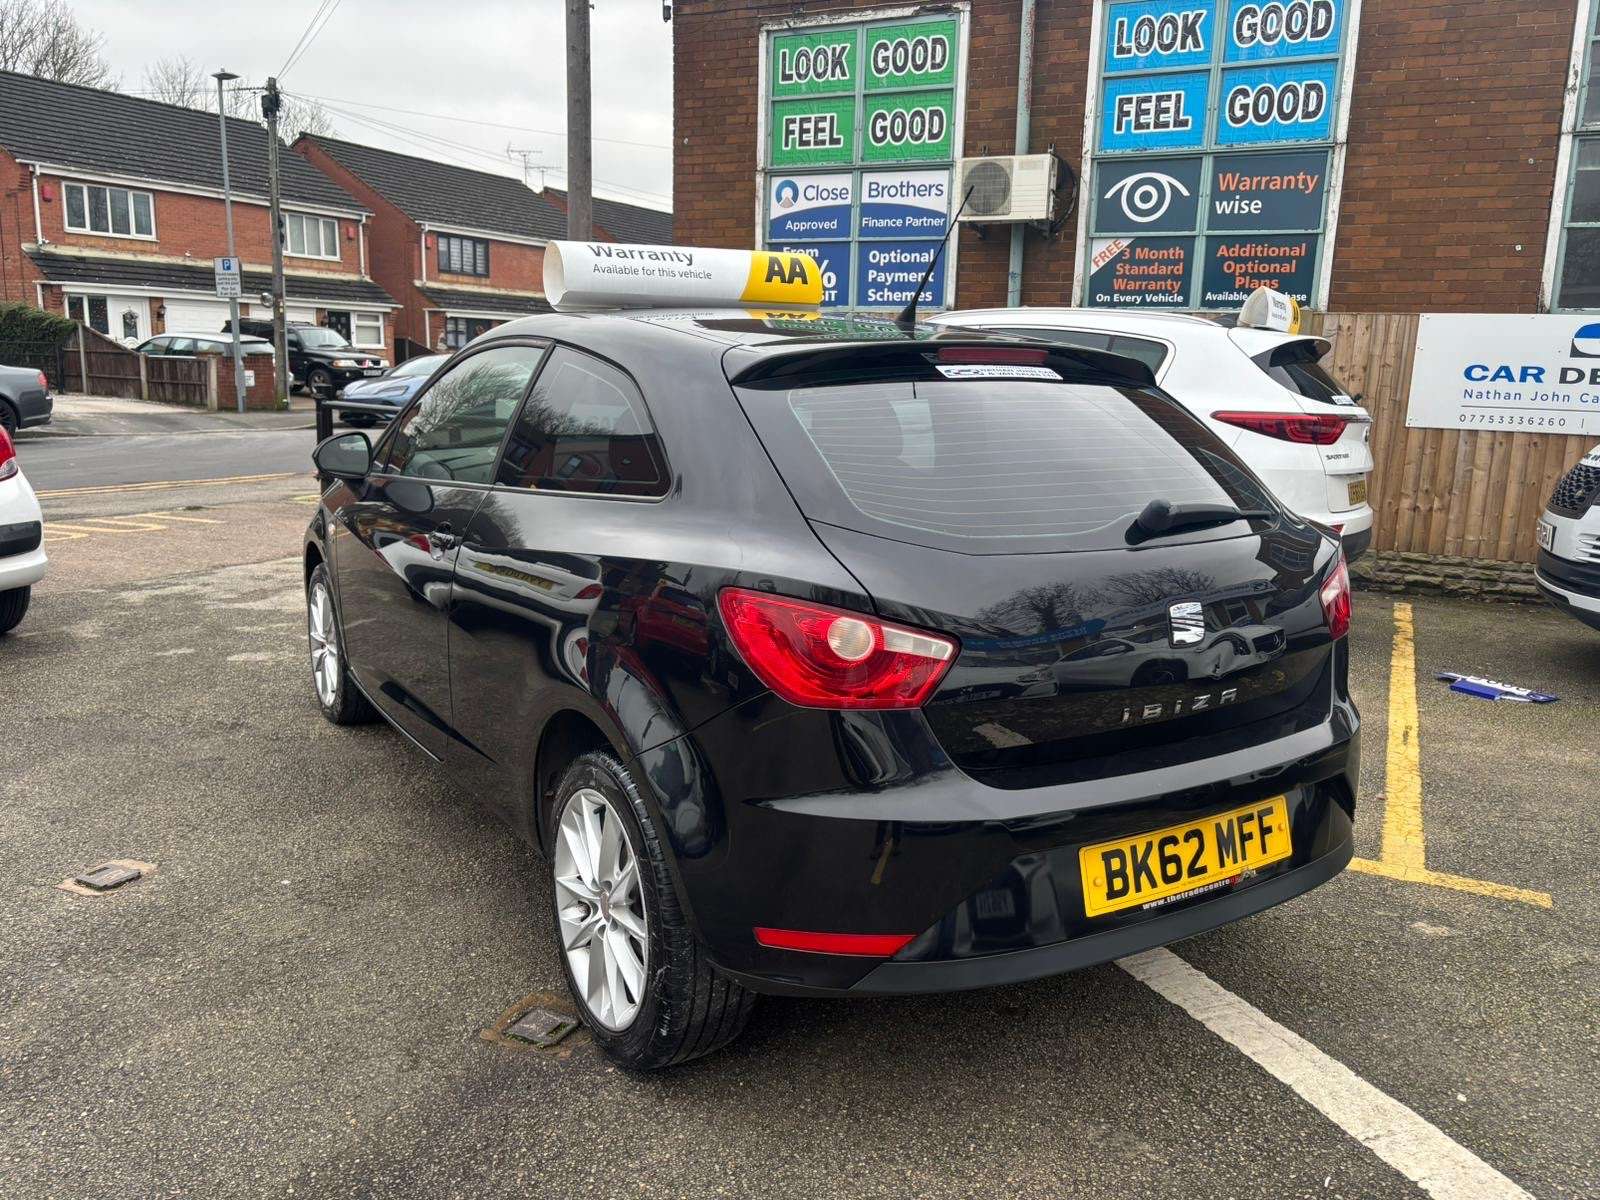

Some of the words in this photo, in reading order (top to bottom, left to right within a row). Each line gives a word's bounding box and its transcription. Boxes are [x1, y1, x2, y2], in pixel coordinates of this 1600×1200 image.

[1115, 11, 1206, 58] LOOK
[1234, 0, 1335, 48] GOOD
[779, 43, 851, 84] LOOK
[871, 34, 949, 78] GOOD
[1114, 91, 1193, 135] FEEL
[1226, 80, 1327, 127] GOOD
[782, 112, 844, 150] FEEL
[869, 106, 947, 147] GOOD
[803, 183, 849, 201] Close
[868, 181, 944, 198] Brothers
[1217, 171, 1319, 194] Warranty
[1215, 195, 1262, 214] wise
[785, 219, 837, 232] Approved
[862, 217, 902, 228] Finance
[905, 216, 945, 227] Partner
[587, 243, 693, 266] Warranty
[869, 249, 934, 266] Optional
[1093, 239, 1125, 269] FREE
[1121, 247, 1131, 260] 3
[1135, 246, 1184, 259] Month
[1216, 243, 1306, 257] Additional
[593, 263, 639, 276] Available
[642, 266, 656, 276] for
[658, 267, 676, 278] this
[678, 269, 712, 280] vehicle
[765, 256, 808, 285] AA
[1115, 262, 1184, 275] Standard
[1223, 260, 1296, 275] Optional
[1113, 278, 1181, 293] Warranty
[1234, 276, 1279, 289] Plans
[868, 289, 933, 302] Schemes
[1096, 293, 1110, 302] On
[1113, 293, 1142, 304] Every
[1145, 293, 1184, 303] Vehicle
[1205, 291, 1247, 301] Available
[1464, 364, 1546, 383] CAR
[1463, 389, 1522, 401] Nathan
[1530, 391, 1570, 403] John
[1580, 393, 1600, 404] Ca
[1459, 414, 1566, 427] 07753336260
[1102, 828, 1208, 901] BK62
[1215, 806, 1274, 869] MFF
